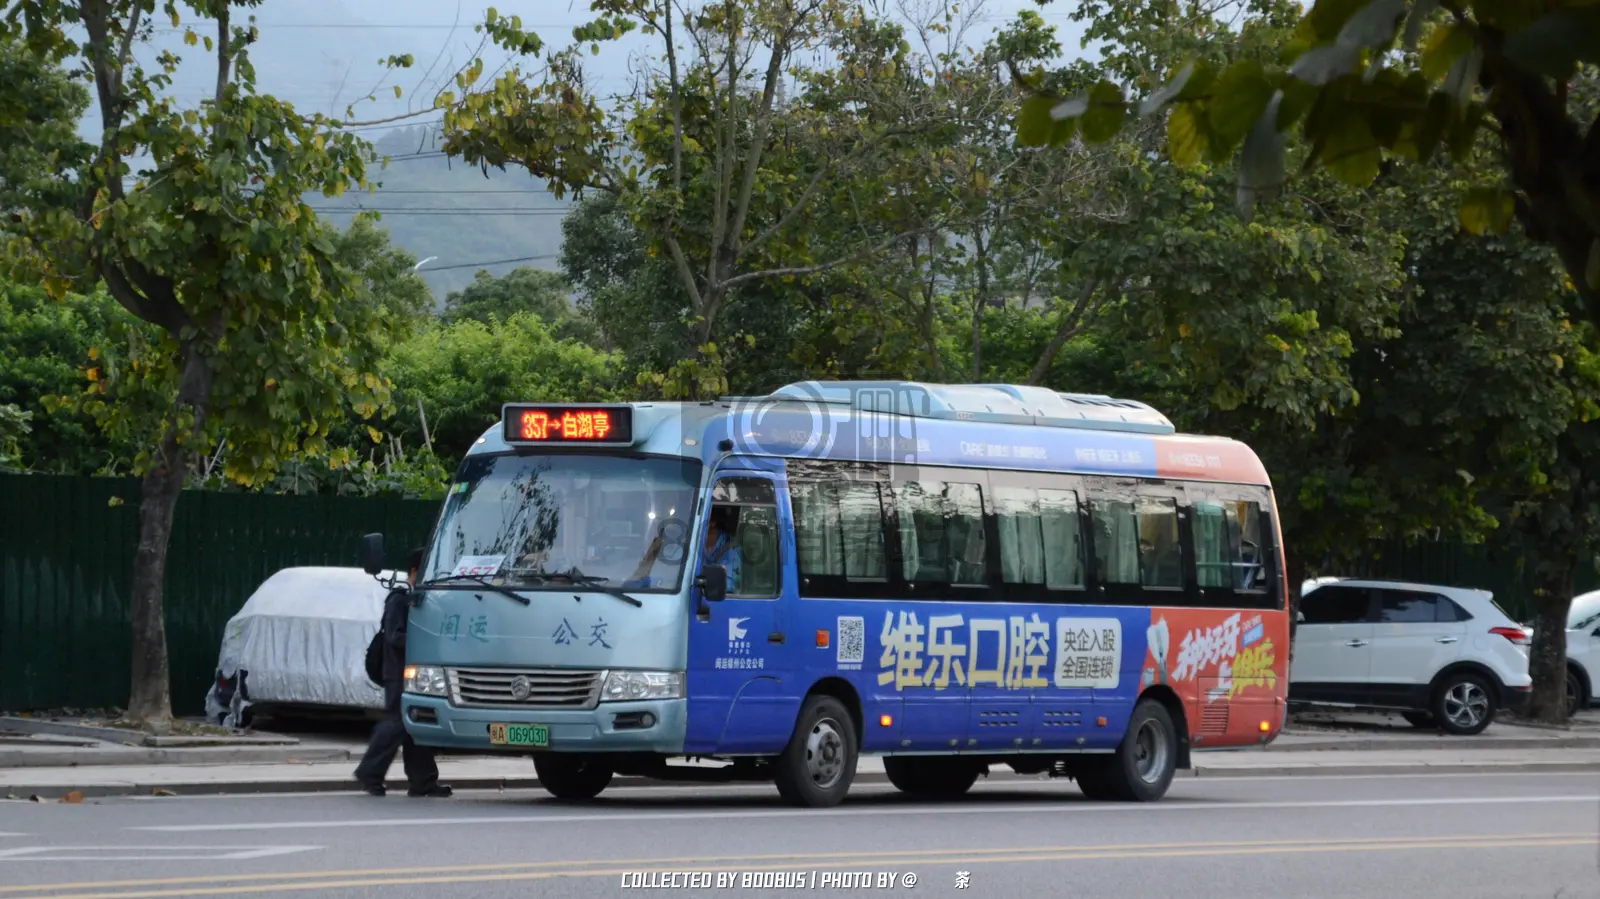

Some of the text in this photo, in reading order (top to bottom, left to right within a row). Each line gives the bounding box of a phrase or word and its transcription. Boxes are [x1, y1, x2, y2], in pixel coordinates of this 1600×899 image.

[522, 412, 610, 439] 357 白湖亭
[551, 616, 613, 650] 公交
[1063, 628, 1116, 652] 央企入股
[878, 610, 1050, 691] 维乐口腔
[1062, 656, 1114, 679] 全国连锁
